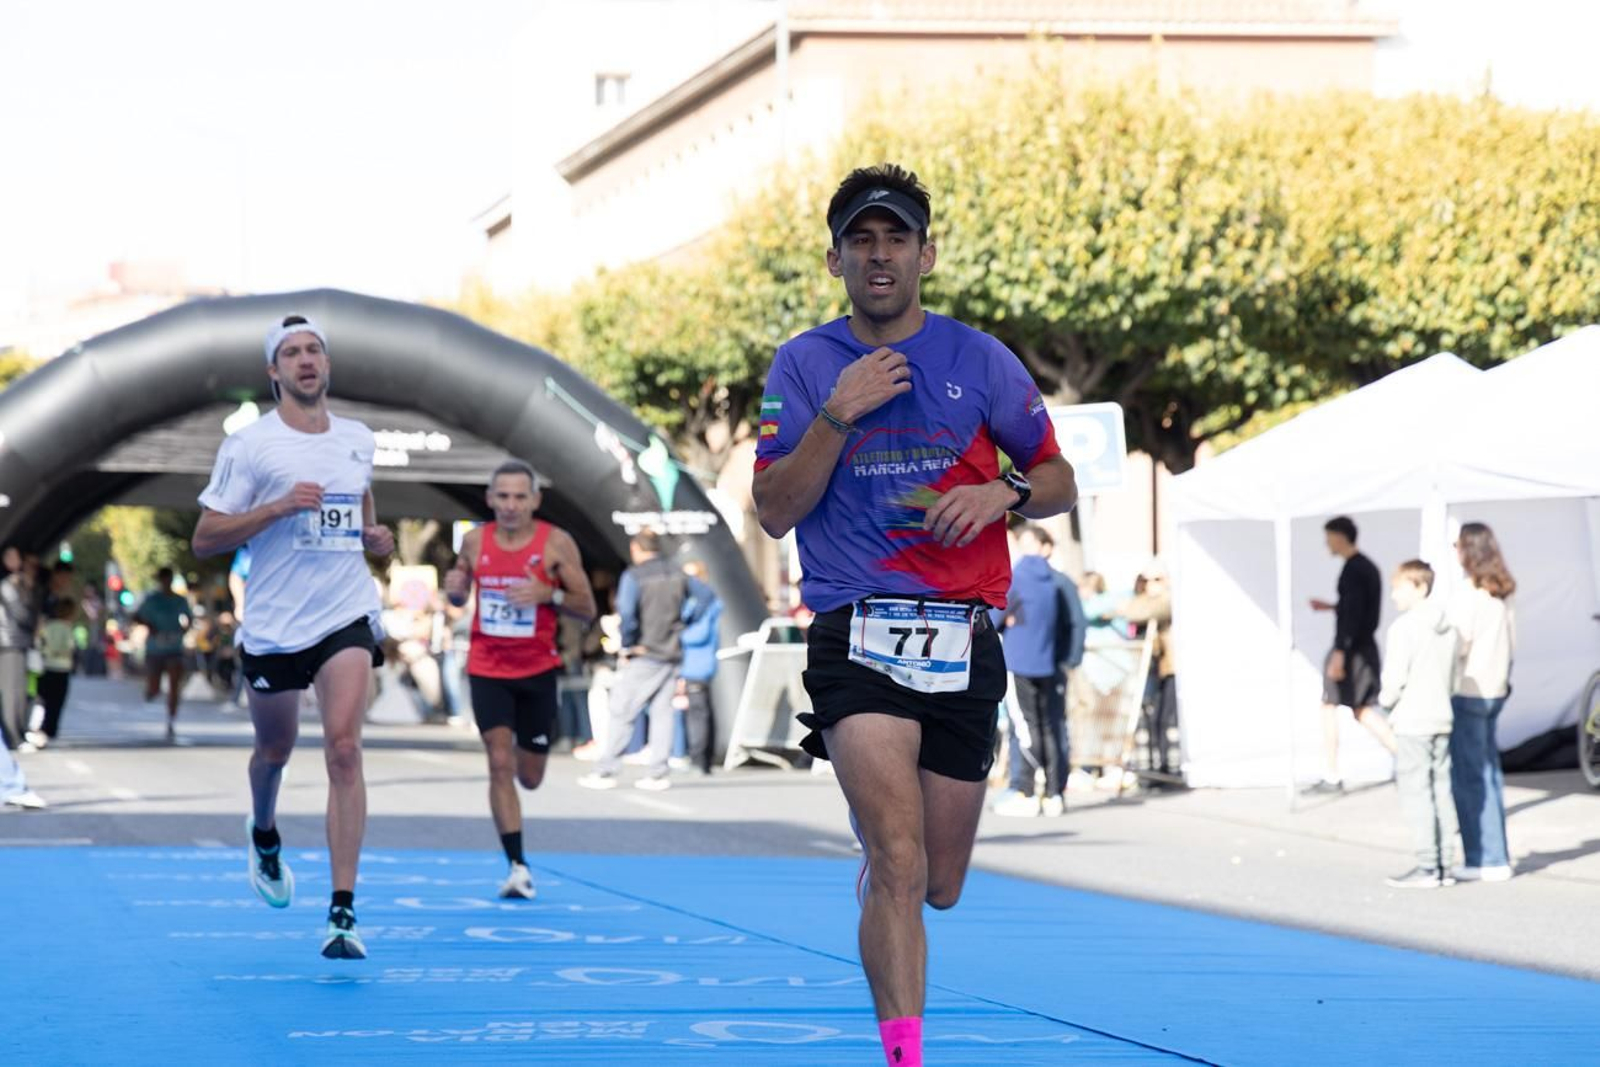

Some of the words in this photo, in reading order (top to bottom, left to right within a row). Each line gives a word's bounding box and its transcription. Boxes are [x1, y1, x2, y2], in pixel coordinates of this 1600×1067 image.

[854, 461, 919, 477] MANCHA
[922, 457, 960, 471] REAL
[889, 627, 939, 658] 77
[897, 659, 931, 668] ANTONIO
